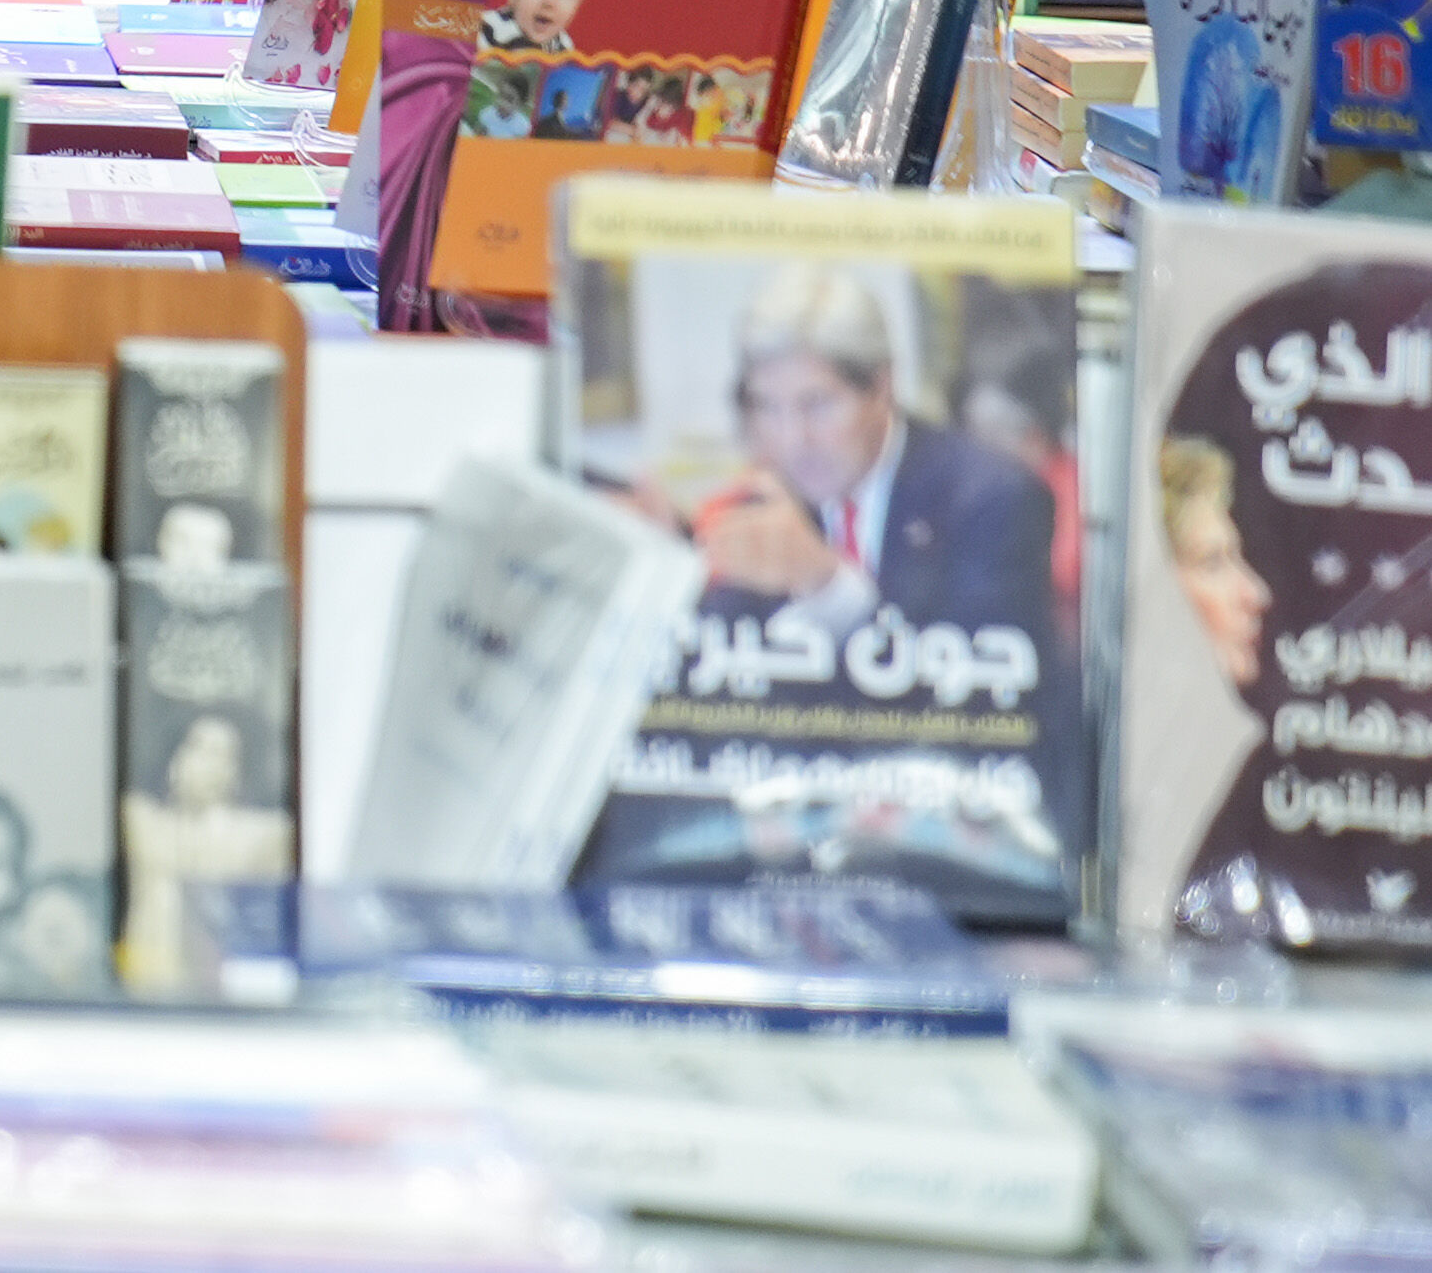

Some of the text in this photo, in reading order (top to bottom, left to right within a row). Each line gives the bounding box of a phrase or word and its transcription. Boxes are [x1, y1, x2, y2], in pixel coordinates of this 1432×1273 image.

[1332, 32, 1412, 100] 16
[1234, 318, 1432, 432] الذي
[1261, 415, 1432, 516] دث
[844, 601, 1040, 711] جون
[1273, 618, 1432, 693] يلاري
[1271, 691, 1432, 758] دهام
